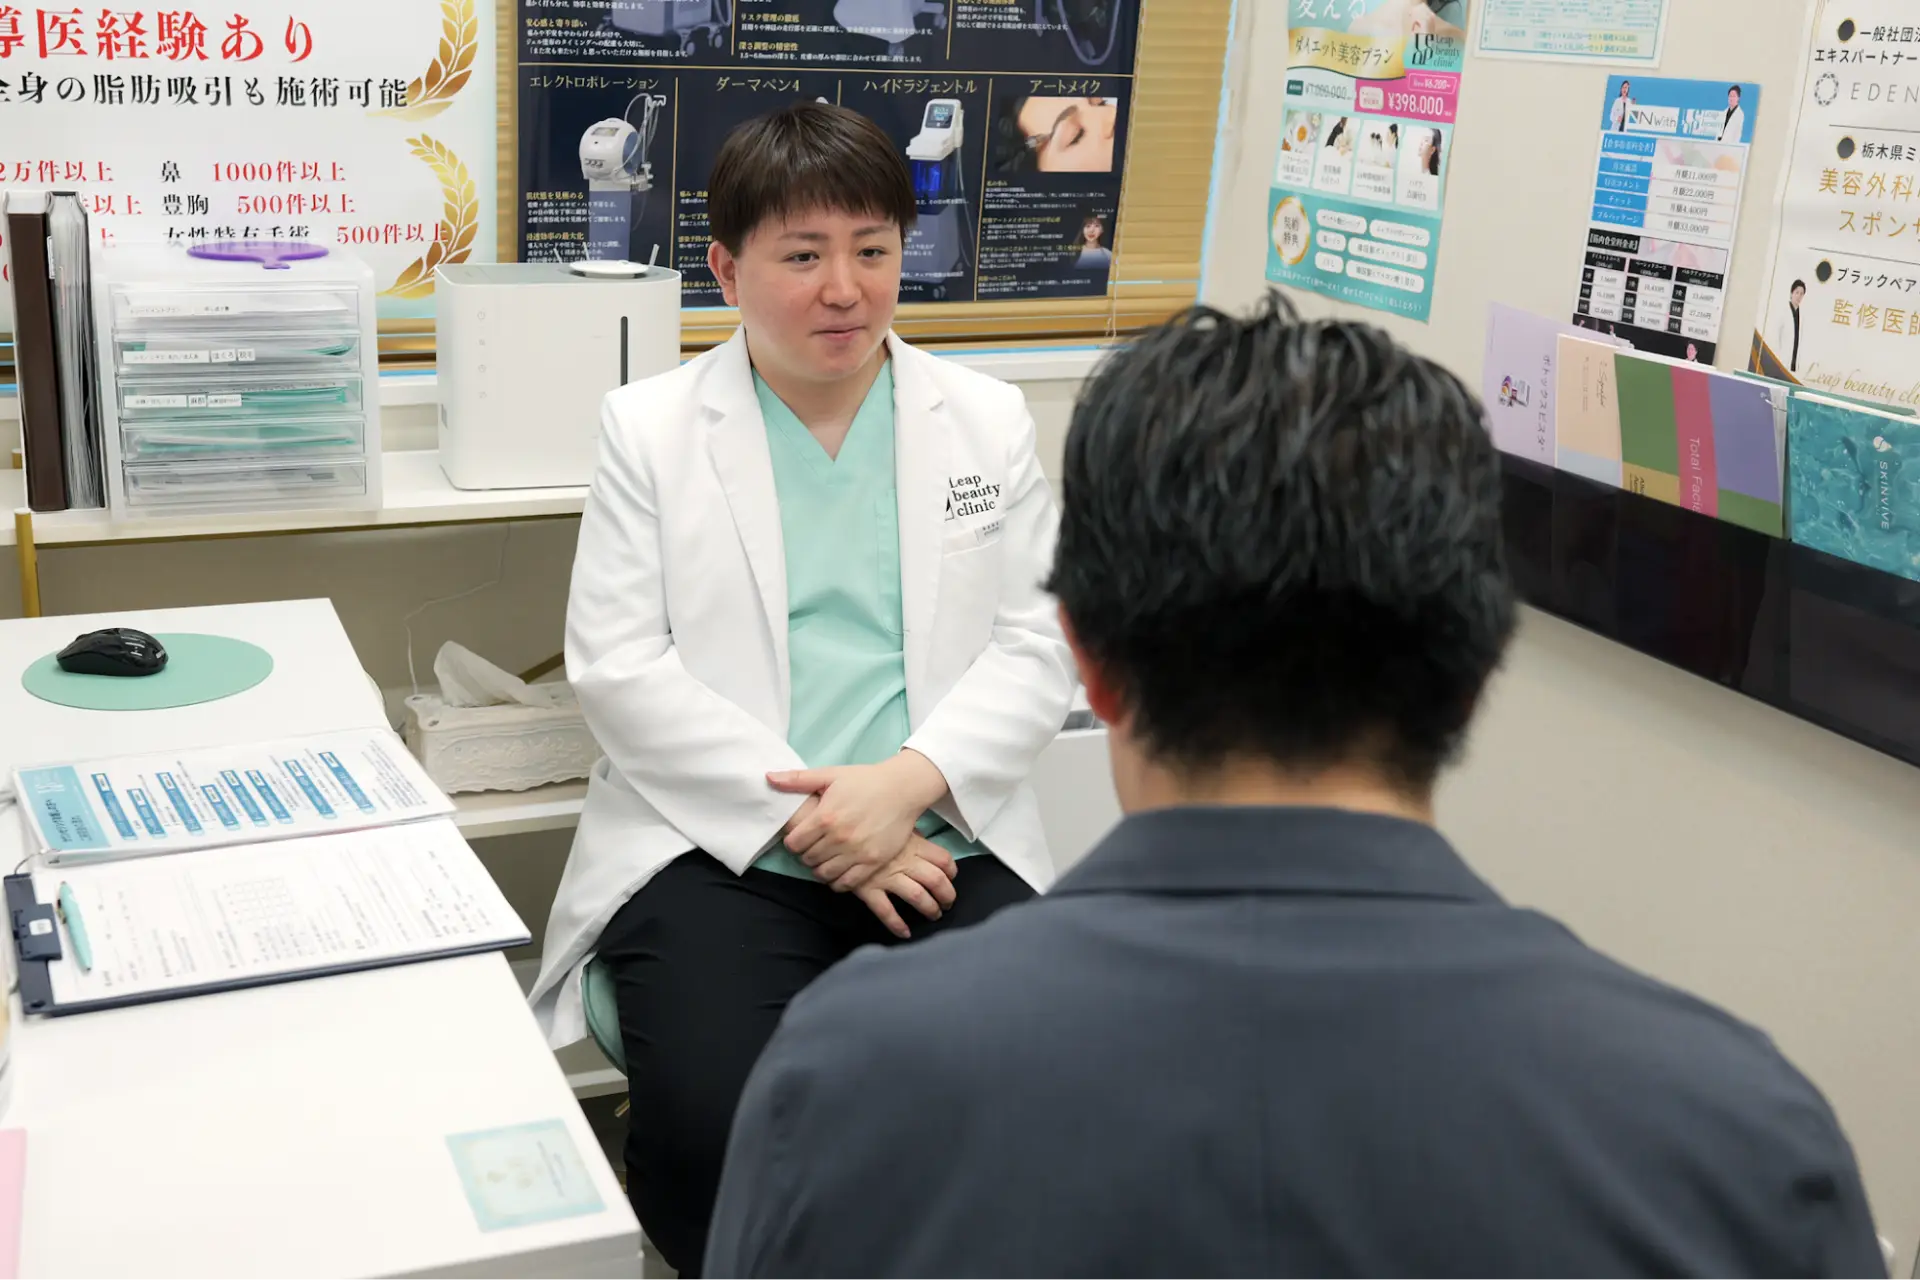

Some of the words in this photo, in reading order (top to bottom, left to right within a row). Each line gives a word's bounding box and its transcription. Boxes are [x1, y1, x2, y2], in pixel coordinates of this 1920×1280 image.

[1295, 35, 1396, 67] ダイエット美容プラン
[1815, 49, 1918, 65] エキスパートナー
[529, 75, 660, 90] エレクトロポレーション
[716, 77, 800, 92] ダーマペン4
[863, 78, 978, 94] ハイドラジェントル
[1029, 80, 1101, 94] アートメイク
[1862, 142, 1920, 161] 栃木県ミ
[160, 160, 182, 183] 鼻
[211, 161, 347, 183] 1000件以上
[1819, 168, 1920, 202] 美容外科
[82, 194, 142, 216] 以上
[161, 194, 210, 216] 豊胸
[237, 193, 356, 215] 500件以上
[336, 223, 448, 245] 500件以上
[1837, 268, 1920, 294] ブラックペア
[1689, 437, 1702, 470] Total
[948, 475, 982, 488] Leap
[952, 483, 1001, 502] beauty
[1880, 460, 1890, 530] SKINVIVE
[956, 498, 997, 517] clinic
